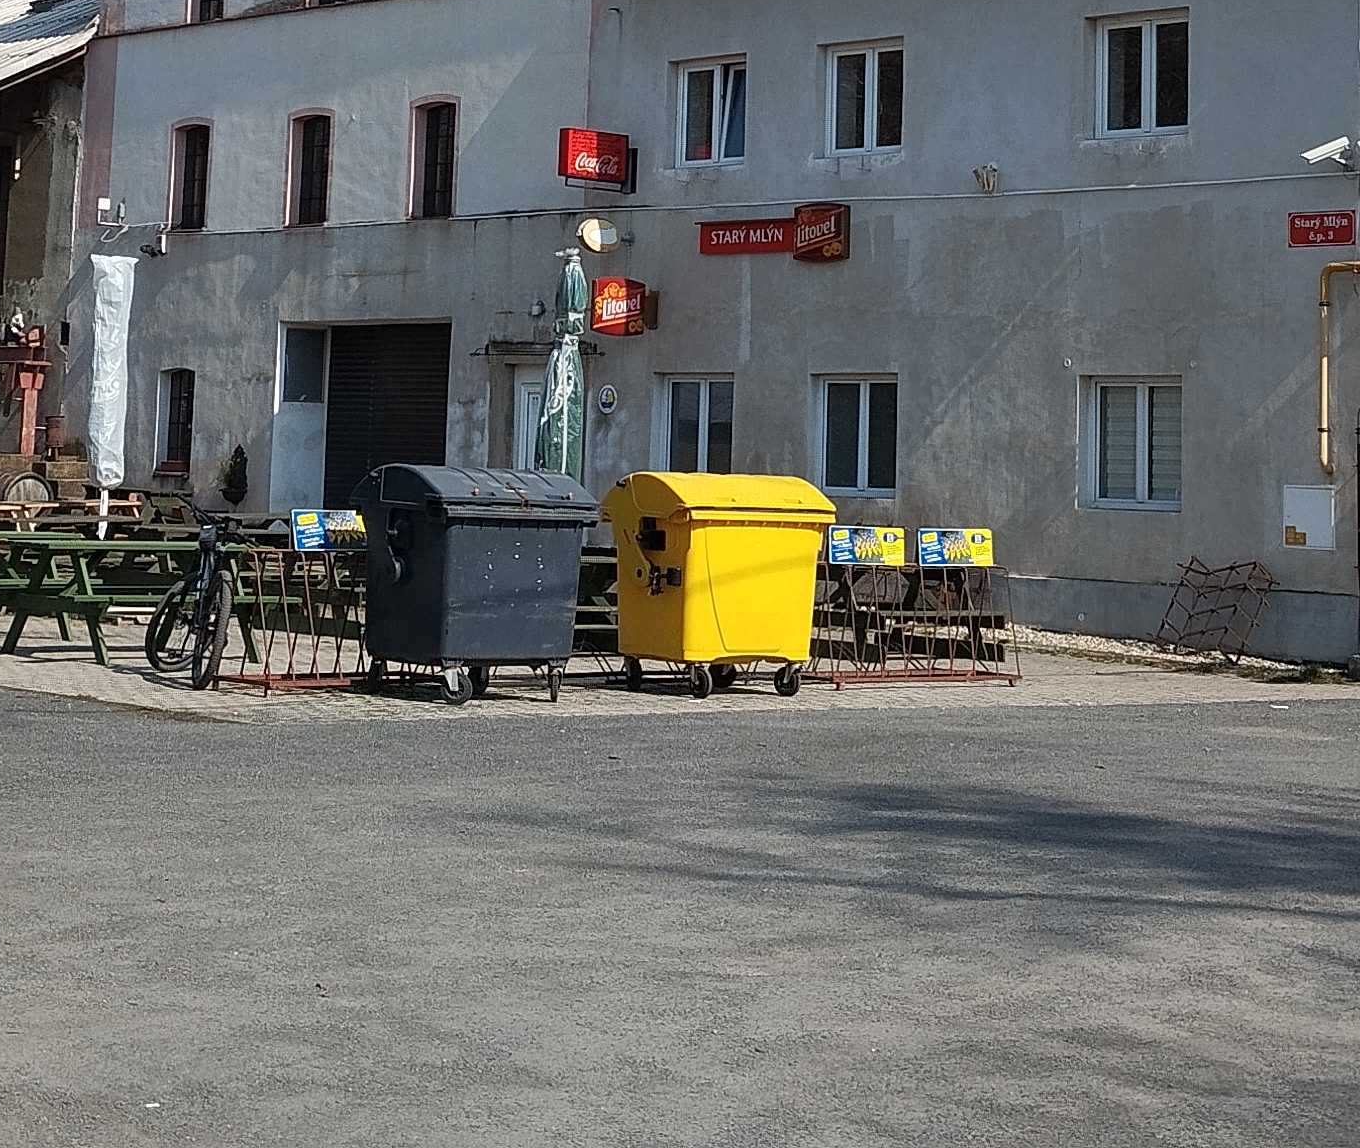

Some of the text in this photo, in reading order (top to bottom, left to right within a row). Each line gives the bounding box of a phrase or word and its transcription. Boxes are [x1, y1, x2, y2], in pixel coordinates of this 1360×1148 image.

[796, 215, 836, 247] Litovel
[1294, 216, 1348, 229] Starý Mlýn
[710, 223, 783, 245] STARÝ MLÝN
[1328, 231, 1334, 240] 3
[602, 294, 641, 321] Litovel
